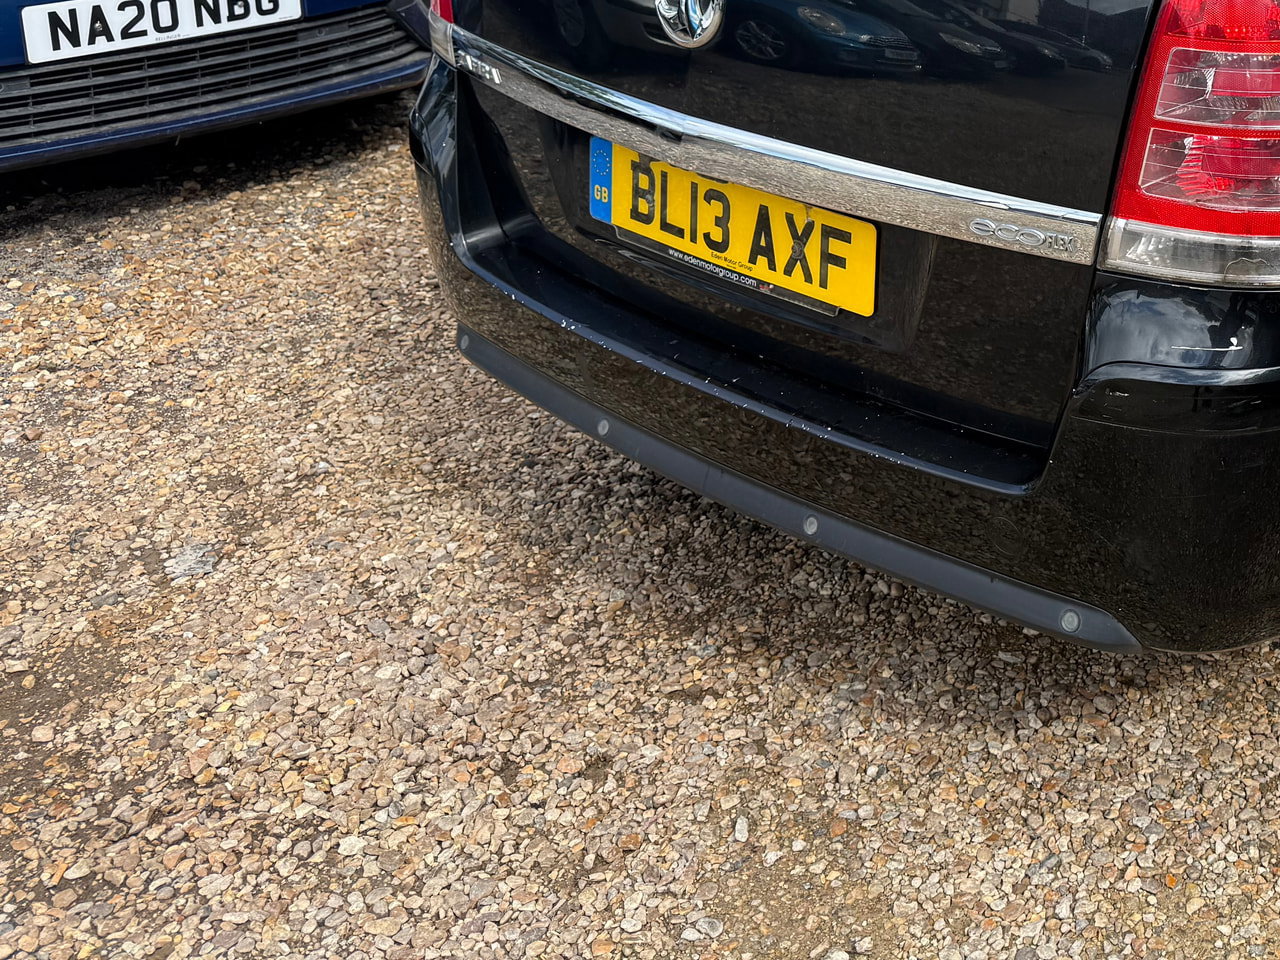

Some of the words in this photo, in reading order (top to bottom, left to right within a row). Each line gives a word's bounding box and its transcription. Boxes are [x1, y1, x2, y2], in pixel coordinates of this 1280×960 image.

[593, 185, 609, 203] GB
[629, 160, 731, 254] BL13
[747, 203, 852, 290] AXF
[668, 248, 757, 287] www.edenmotorgroup.com
[710, 251, 724, 261] Eden
[723, 256, 738, 266] Motor
[738, 261, 754, 272] Group
